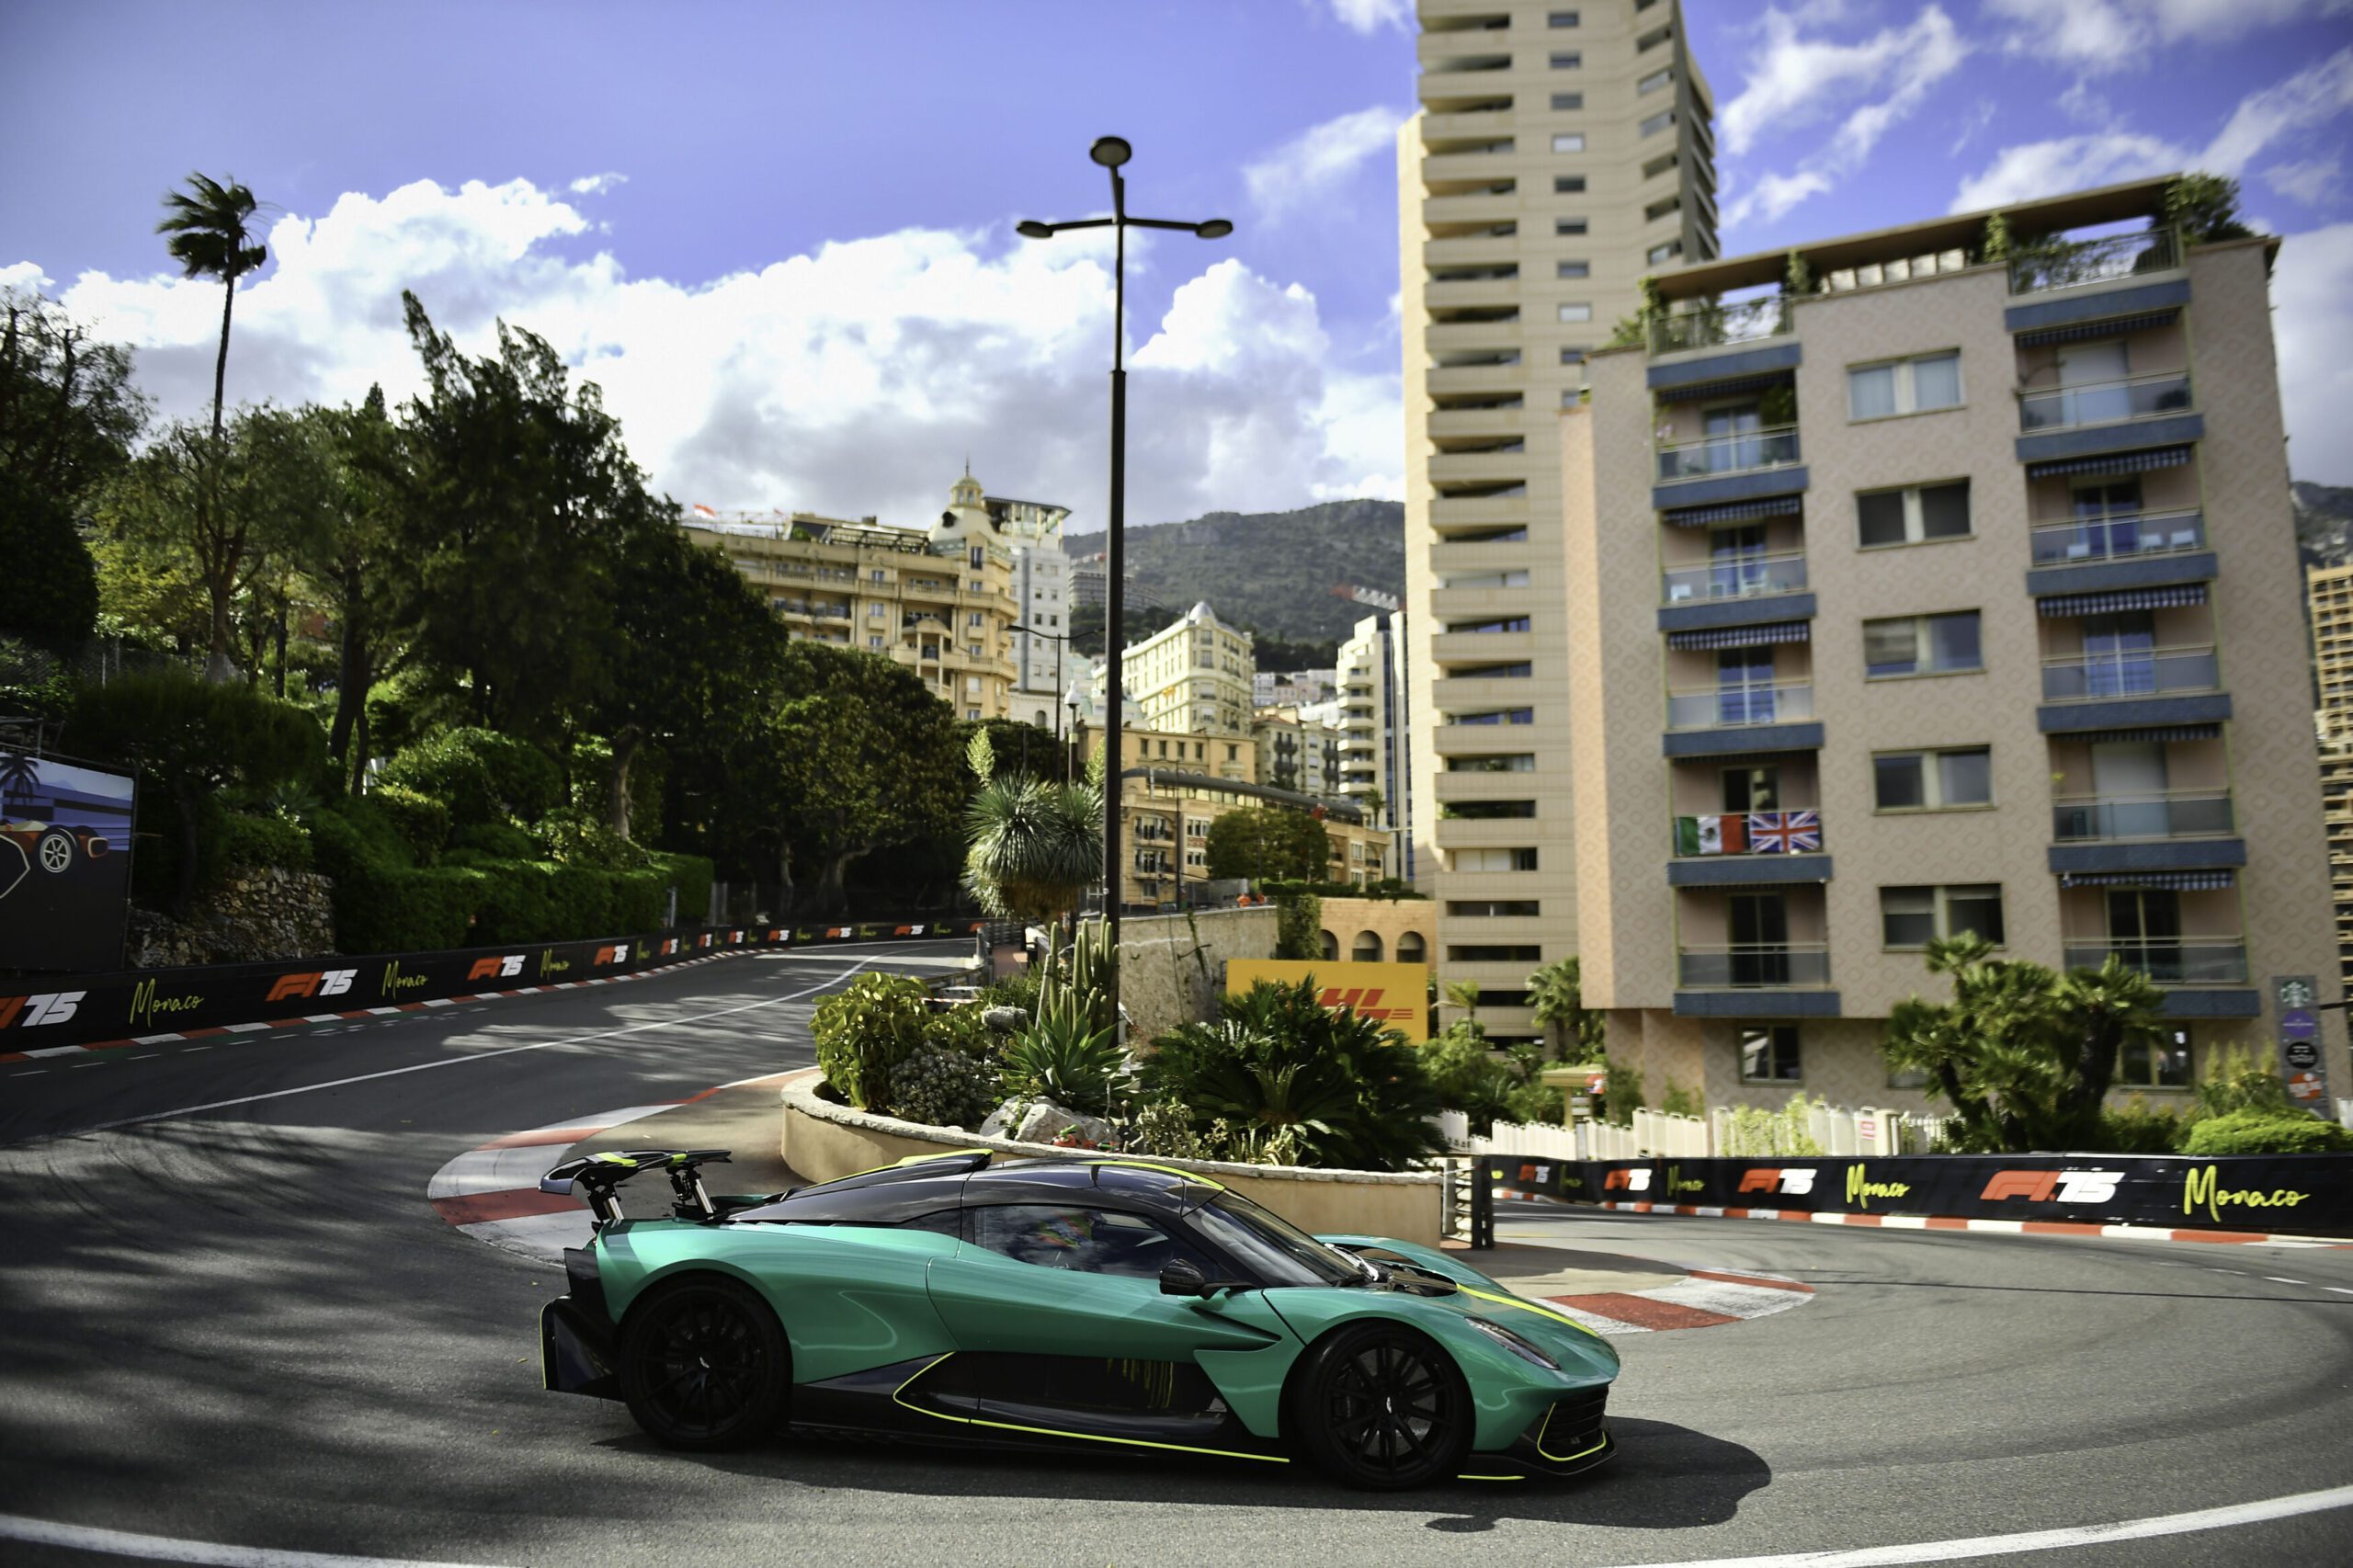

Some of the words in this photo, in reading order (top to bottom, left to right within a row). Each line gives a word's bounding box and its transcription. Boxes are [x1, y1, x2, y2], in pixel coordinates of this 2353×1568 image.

[130, 978, 205, 1028] Monaco
[1846, 1163, 1911, 1209] Monaco
[2184, 1165, 2311, 1222] Monaco
